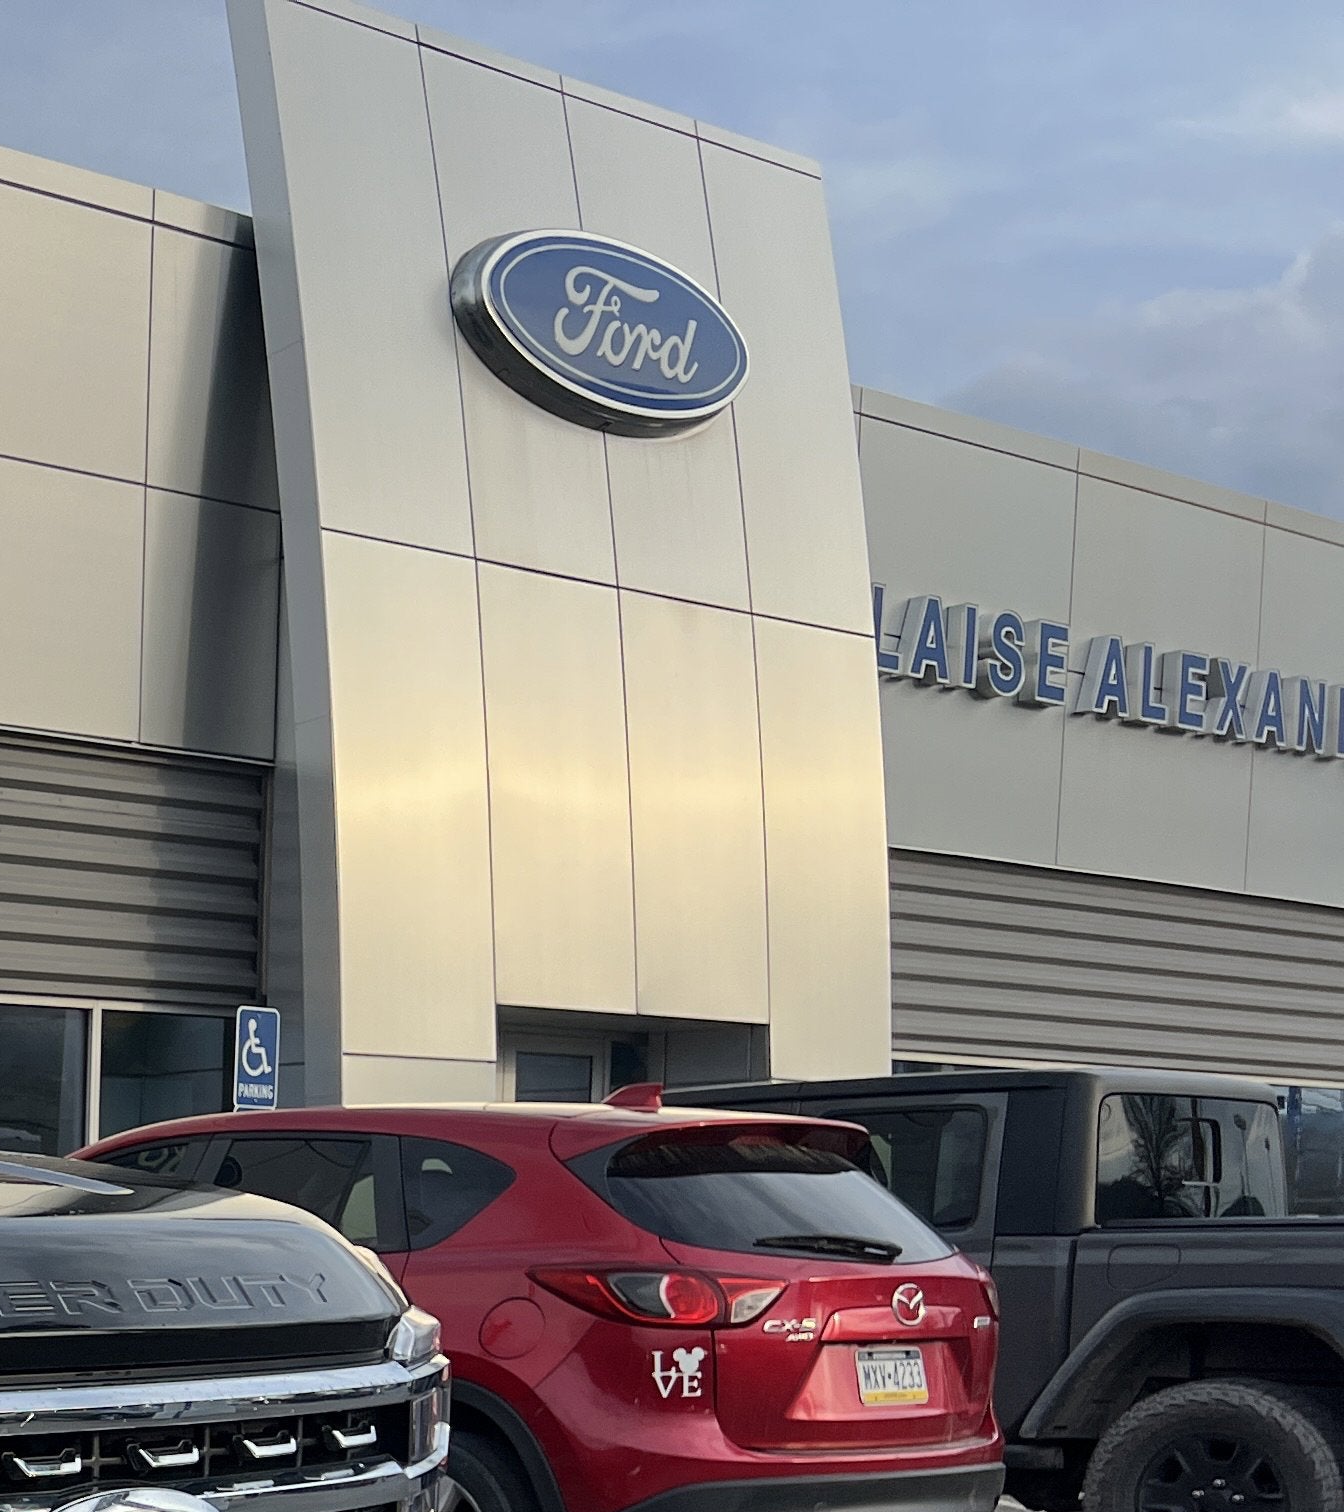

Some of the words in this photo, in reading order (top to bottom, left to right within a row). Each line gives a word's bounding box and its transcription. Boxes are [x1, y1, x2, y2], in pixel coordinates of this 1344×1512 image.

[553, 265, 699, 384] Ford
[1091, 634, 1344, 759] ALEXAN
[237, 1082, 274, 1100] PARKING
[126, 1271, 328, 1314] DUTY
